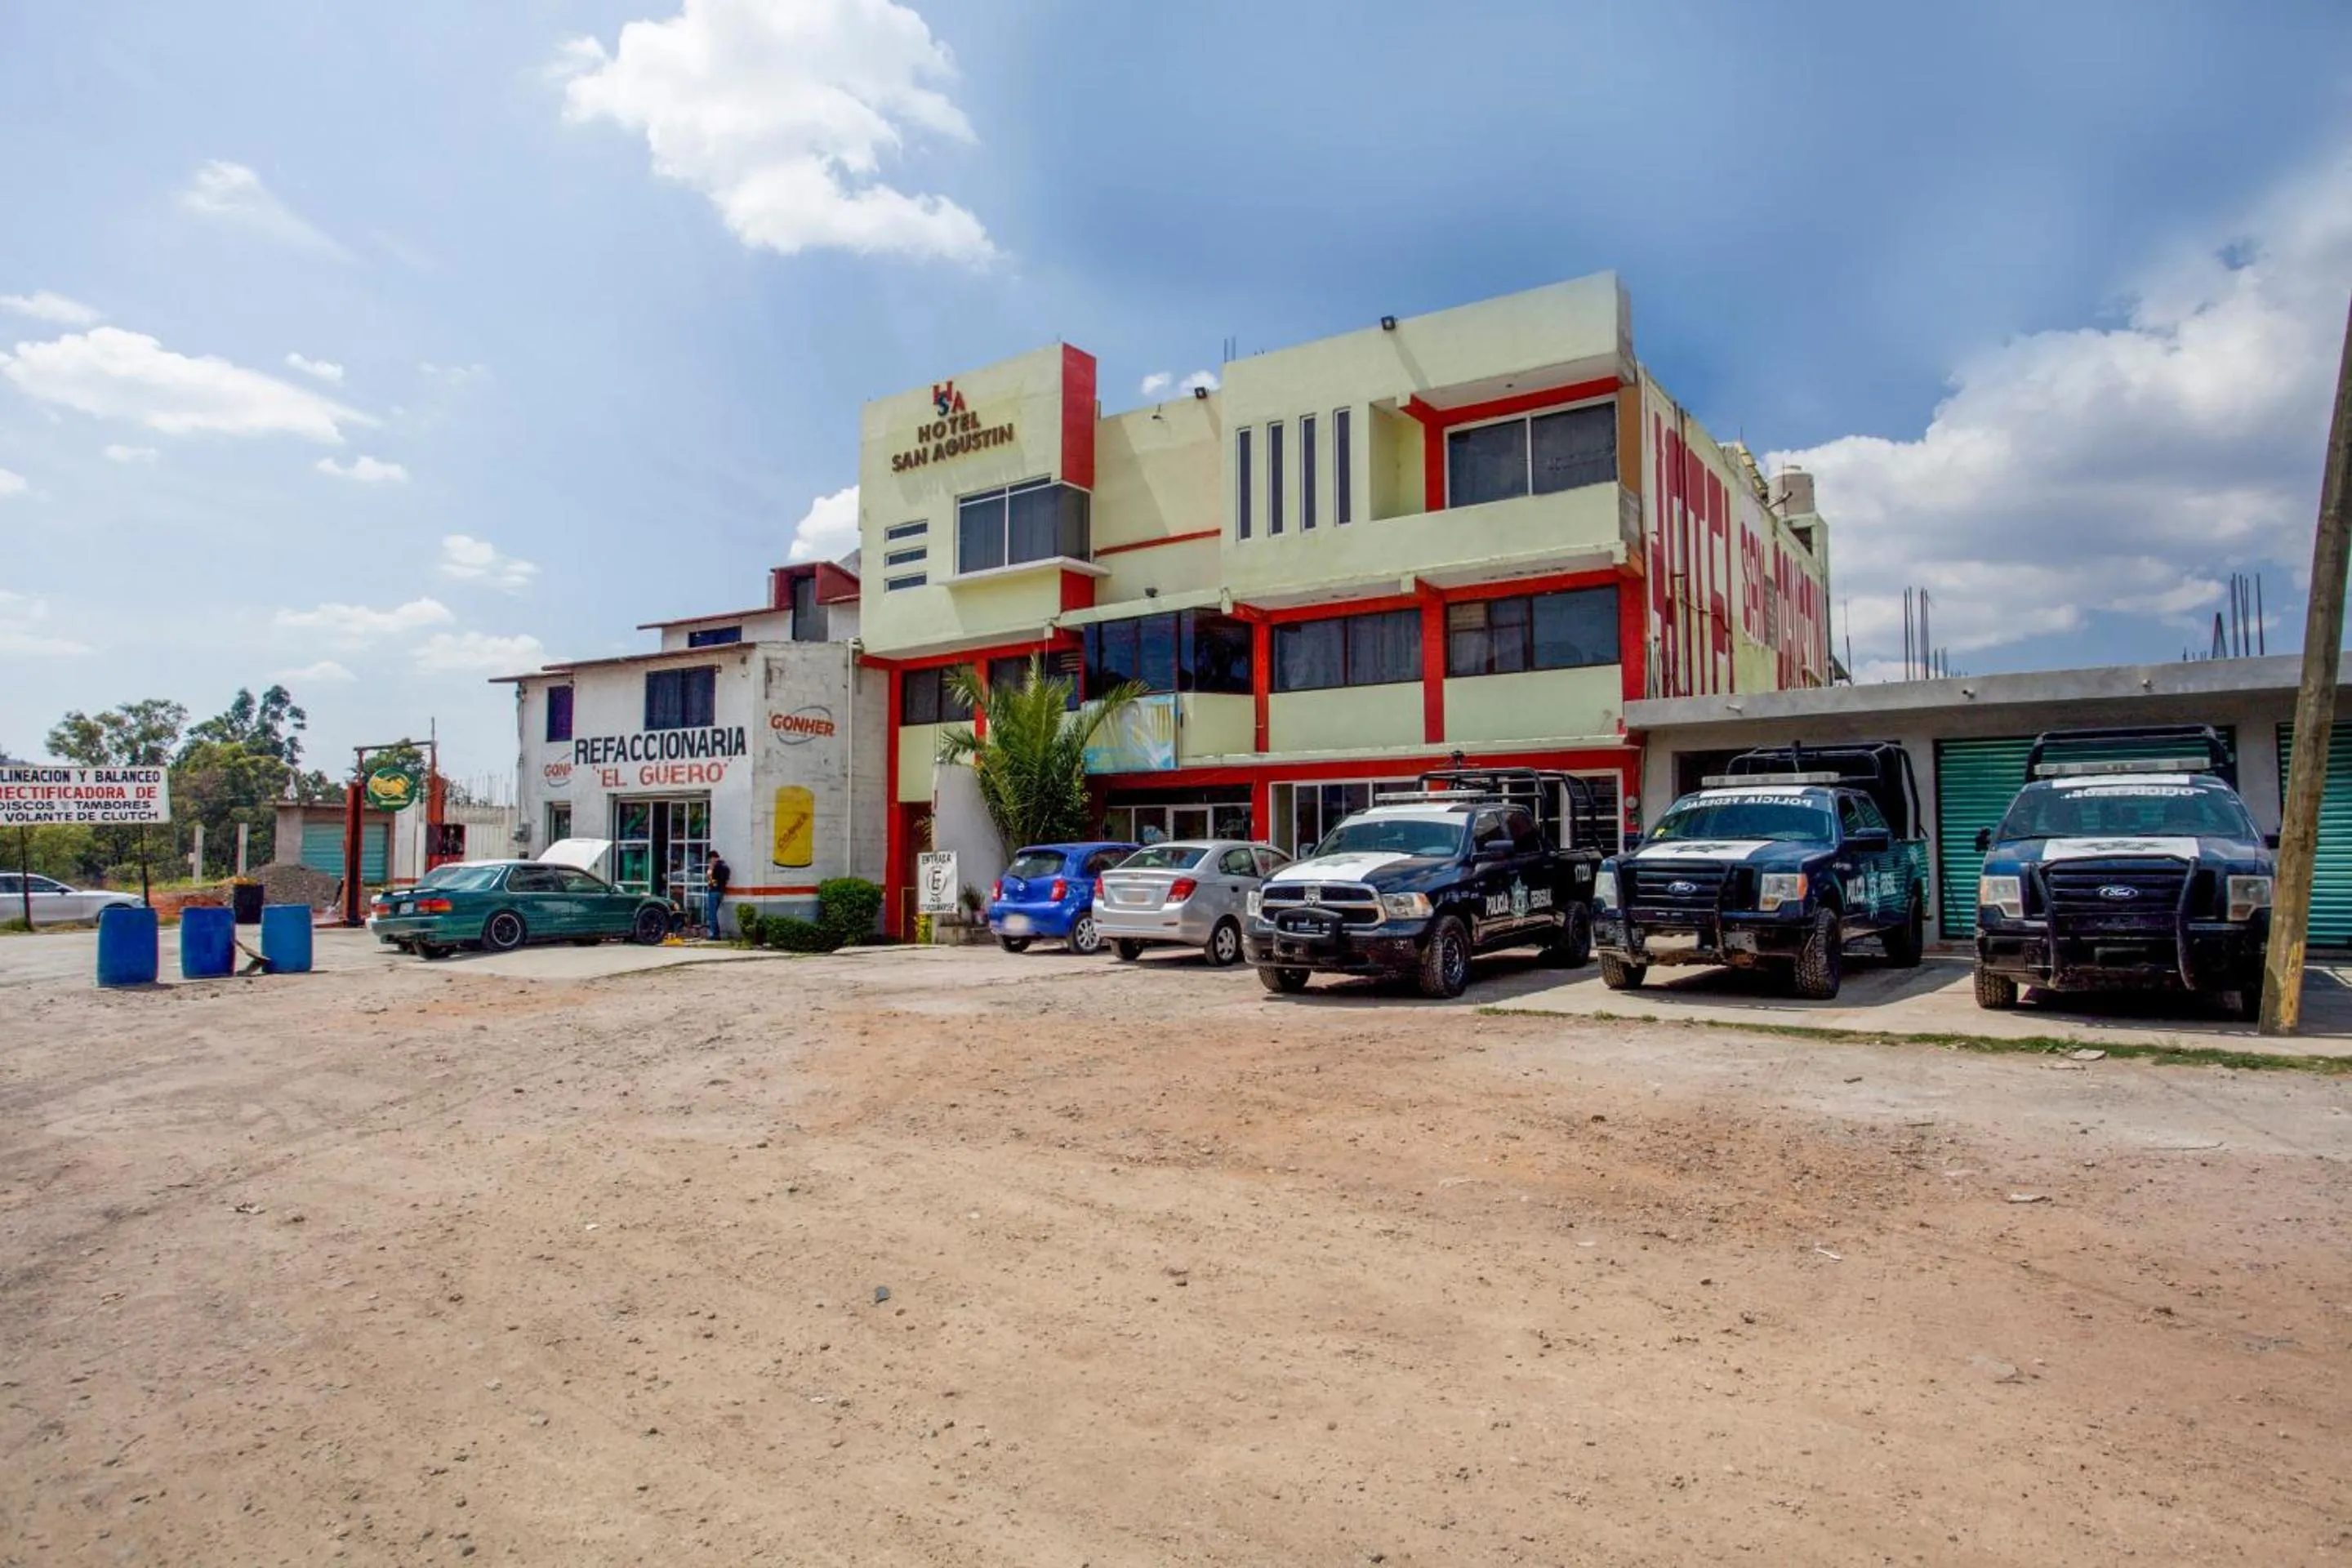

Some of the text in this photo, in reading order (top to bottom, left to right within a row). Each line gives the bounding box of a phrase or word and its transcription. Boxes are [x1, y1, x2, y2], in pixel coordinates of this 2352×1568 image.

[918, 411, 981, 443] HOTEL
[891, 422, 1013, 473] SAN AGUSTIN
[770, 713, 835, 738] GONHER
[574, 726, 747, 765] REFACCIONARIA
[78, 770, 87, 783] Y
[96, 770, 161, 783] BALANCEO
[0, 786, 158, 800] ECTIFICADORA DE
[74, 800, 151, 810] TAMBORES
[5, 810, 158, 822] VOLANTE DE CLUTCH
